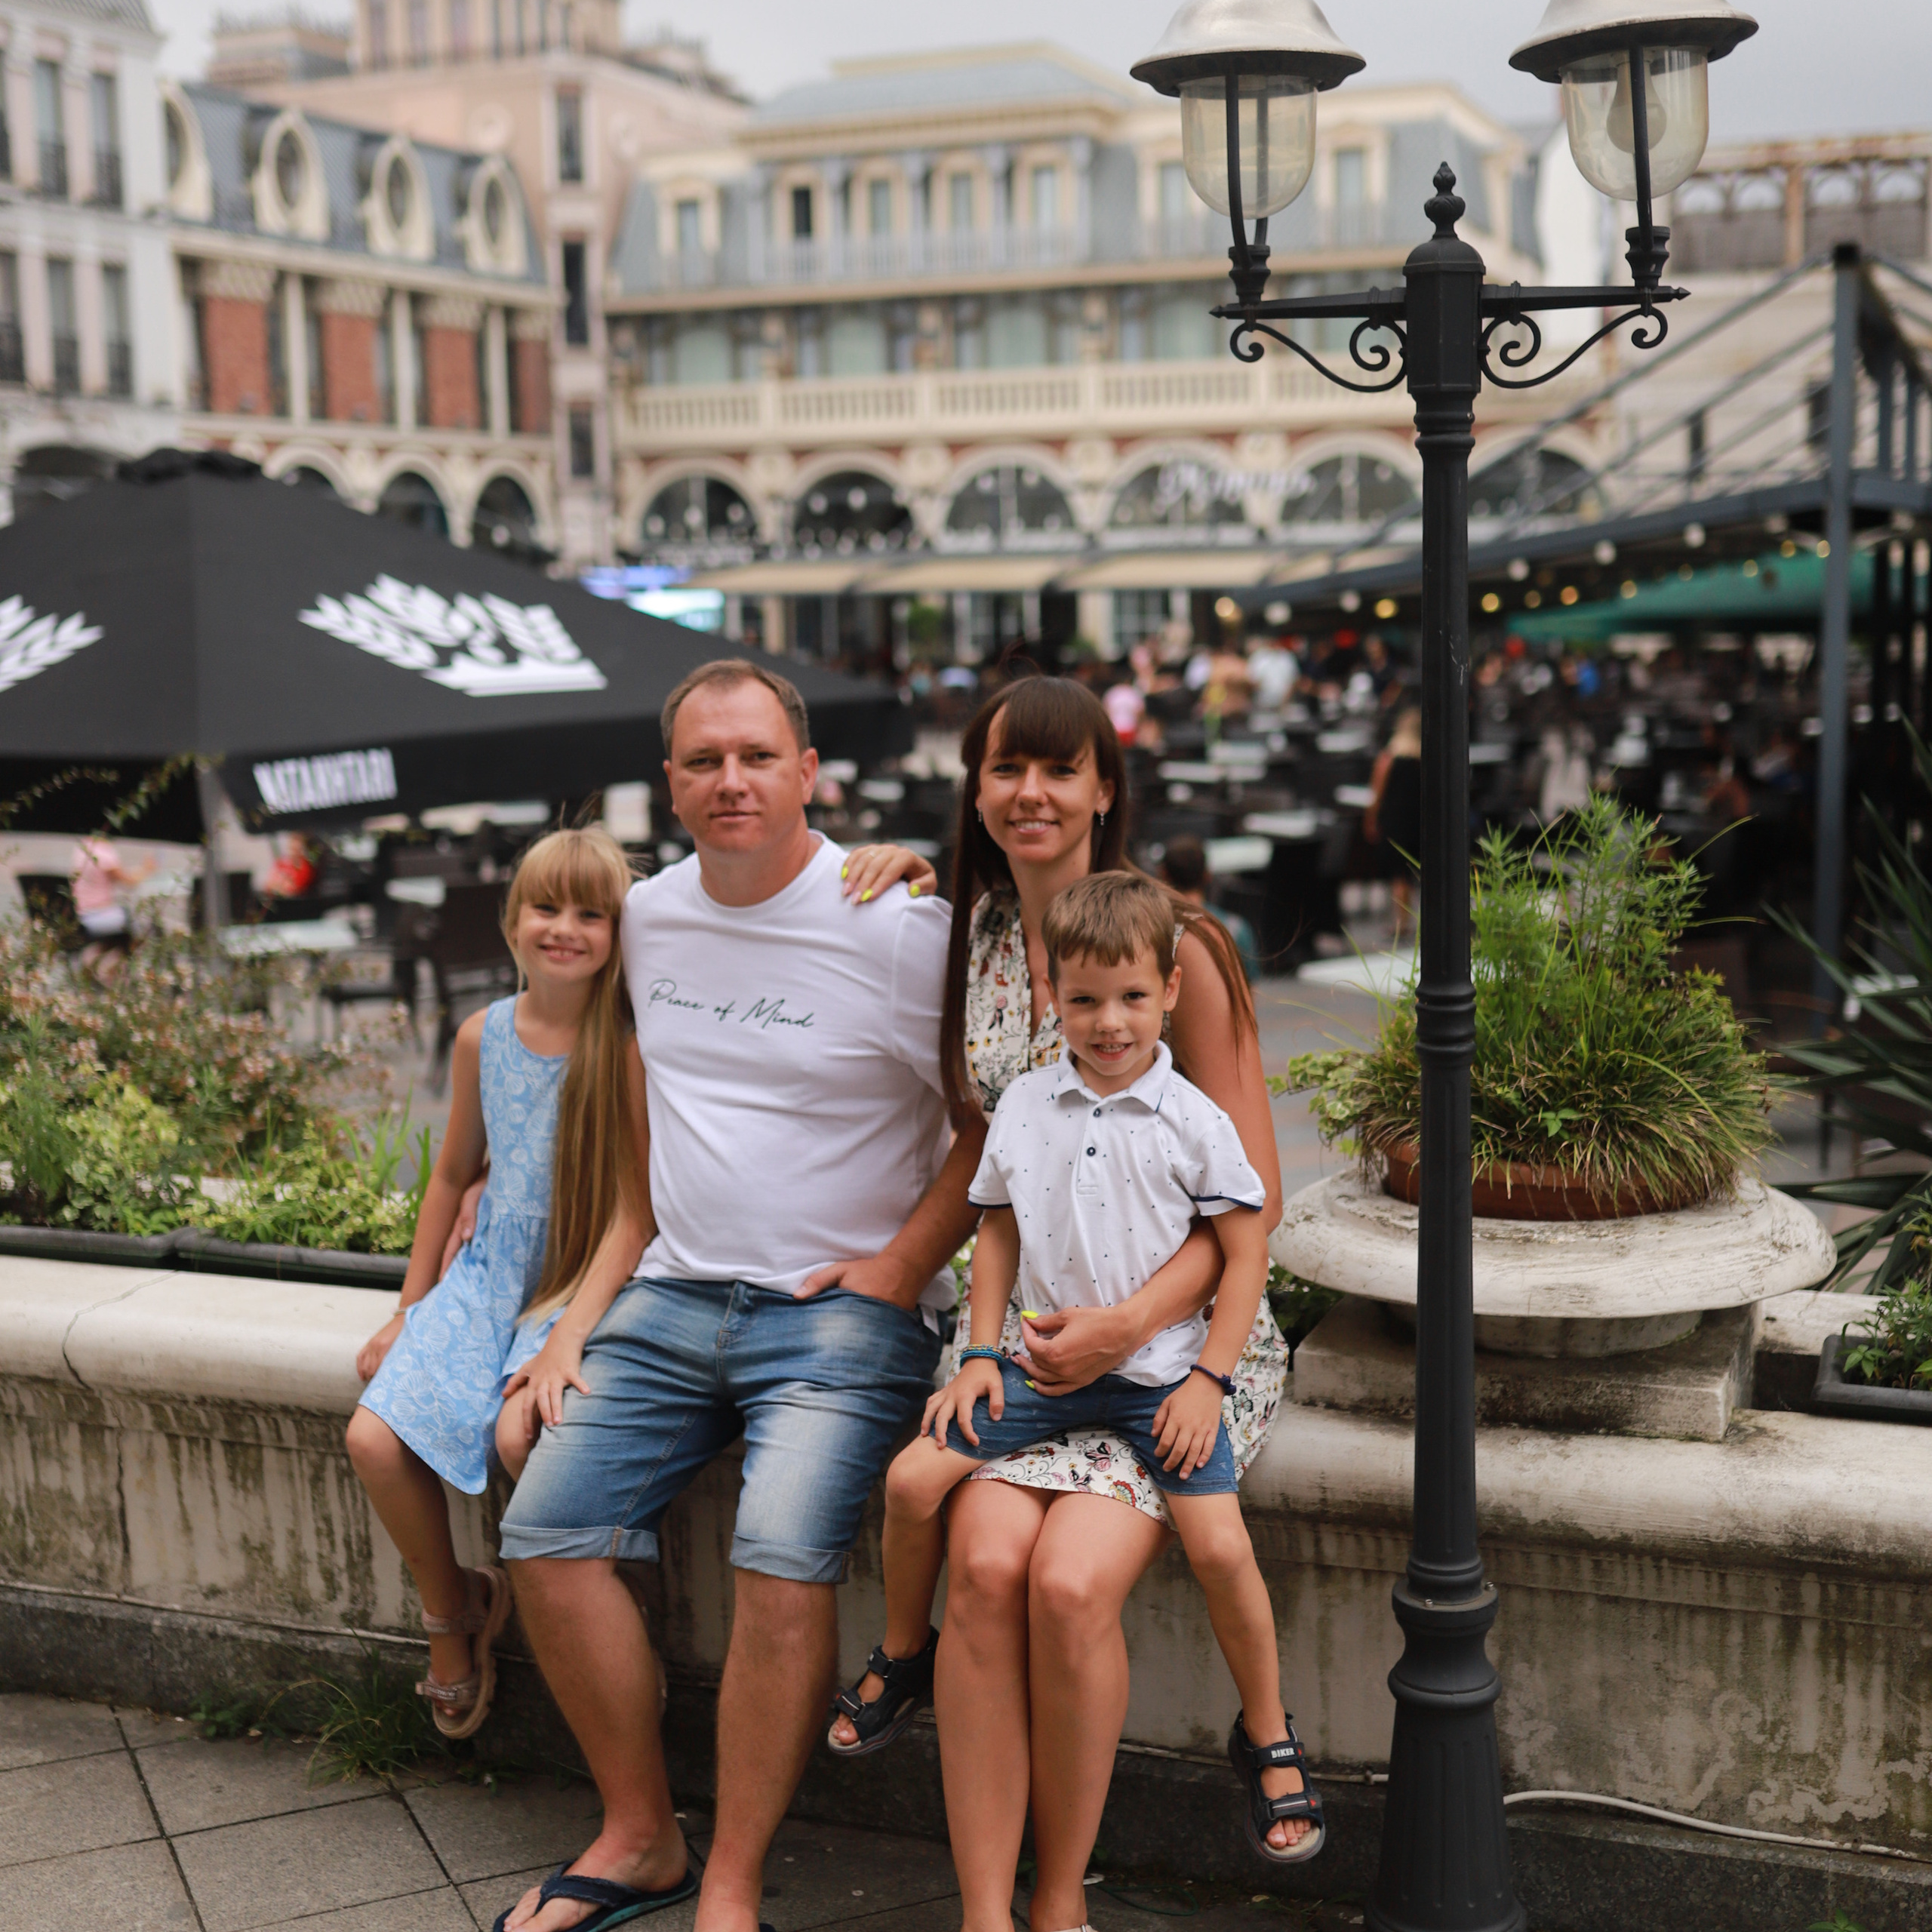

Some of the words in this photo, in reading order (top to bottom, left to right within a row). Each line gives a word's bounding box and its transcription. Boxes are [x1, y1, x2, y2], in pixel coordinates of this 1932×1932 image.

[648, 978, 705, 1008] Peace
[713, 1000, 737, 1022] of
[740, 997, 815, 1029] Mind
[1271, 1747, 1295, 1758] BIKER
